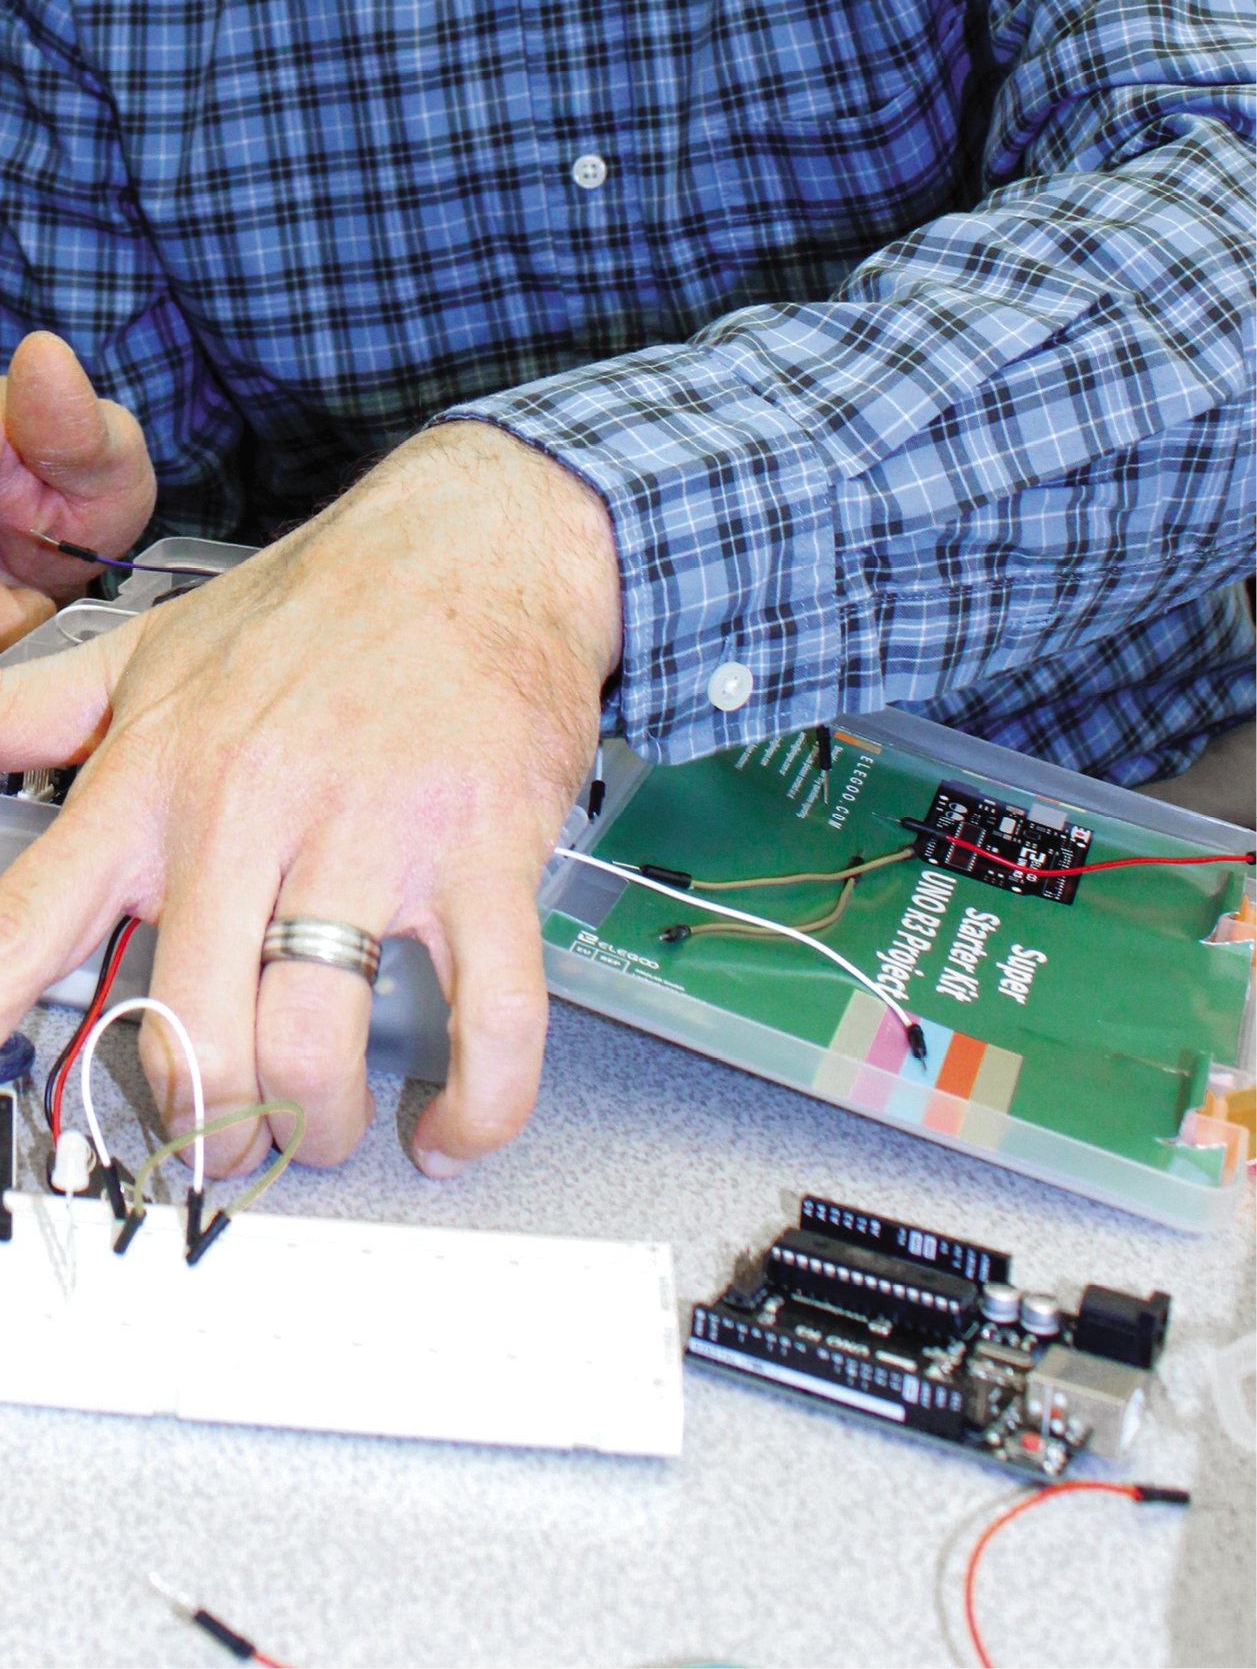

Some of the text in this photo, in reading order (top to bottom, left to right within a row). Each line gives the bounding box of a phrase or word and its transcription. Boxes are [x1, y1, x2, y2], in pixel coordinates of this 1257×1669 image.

[828, 755, 874, 830] ELEGOO.COM
[598, 942, 660, 970] ELEGOO
[875, 870, 957, 1002] UNO R3 Project
[935, 906, 1001, 1003] Starter Kit
[996, 943, 1048, 1006] Super
